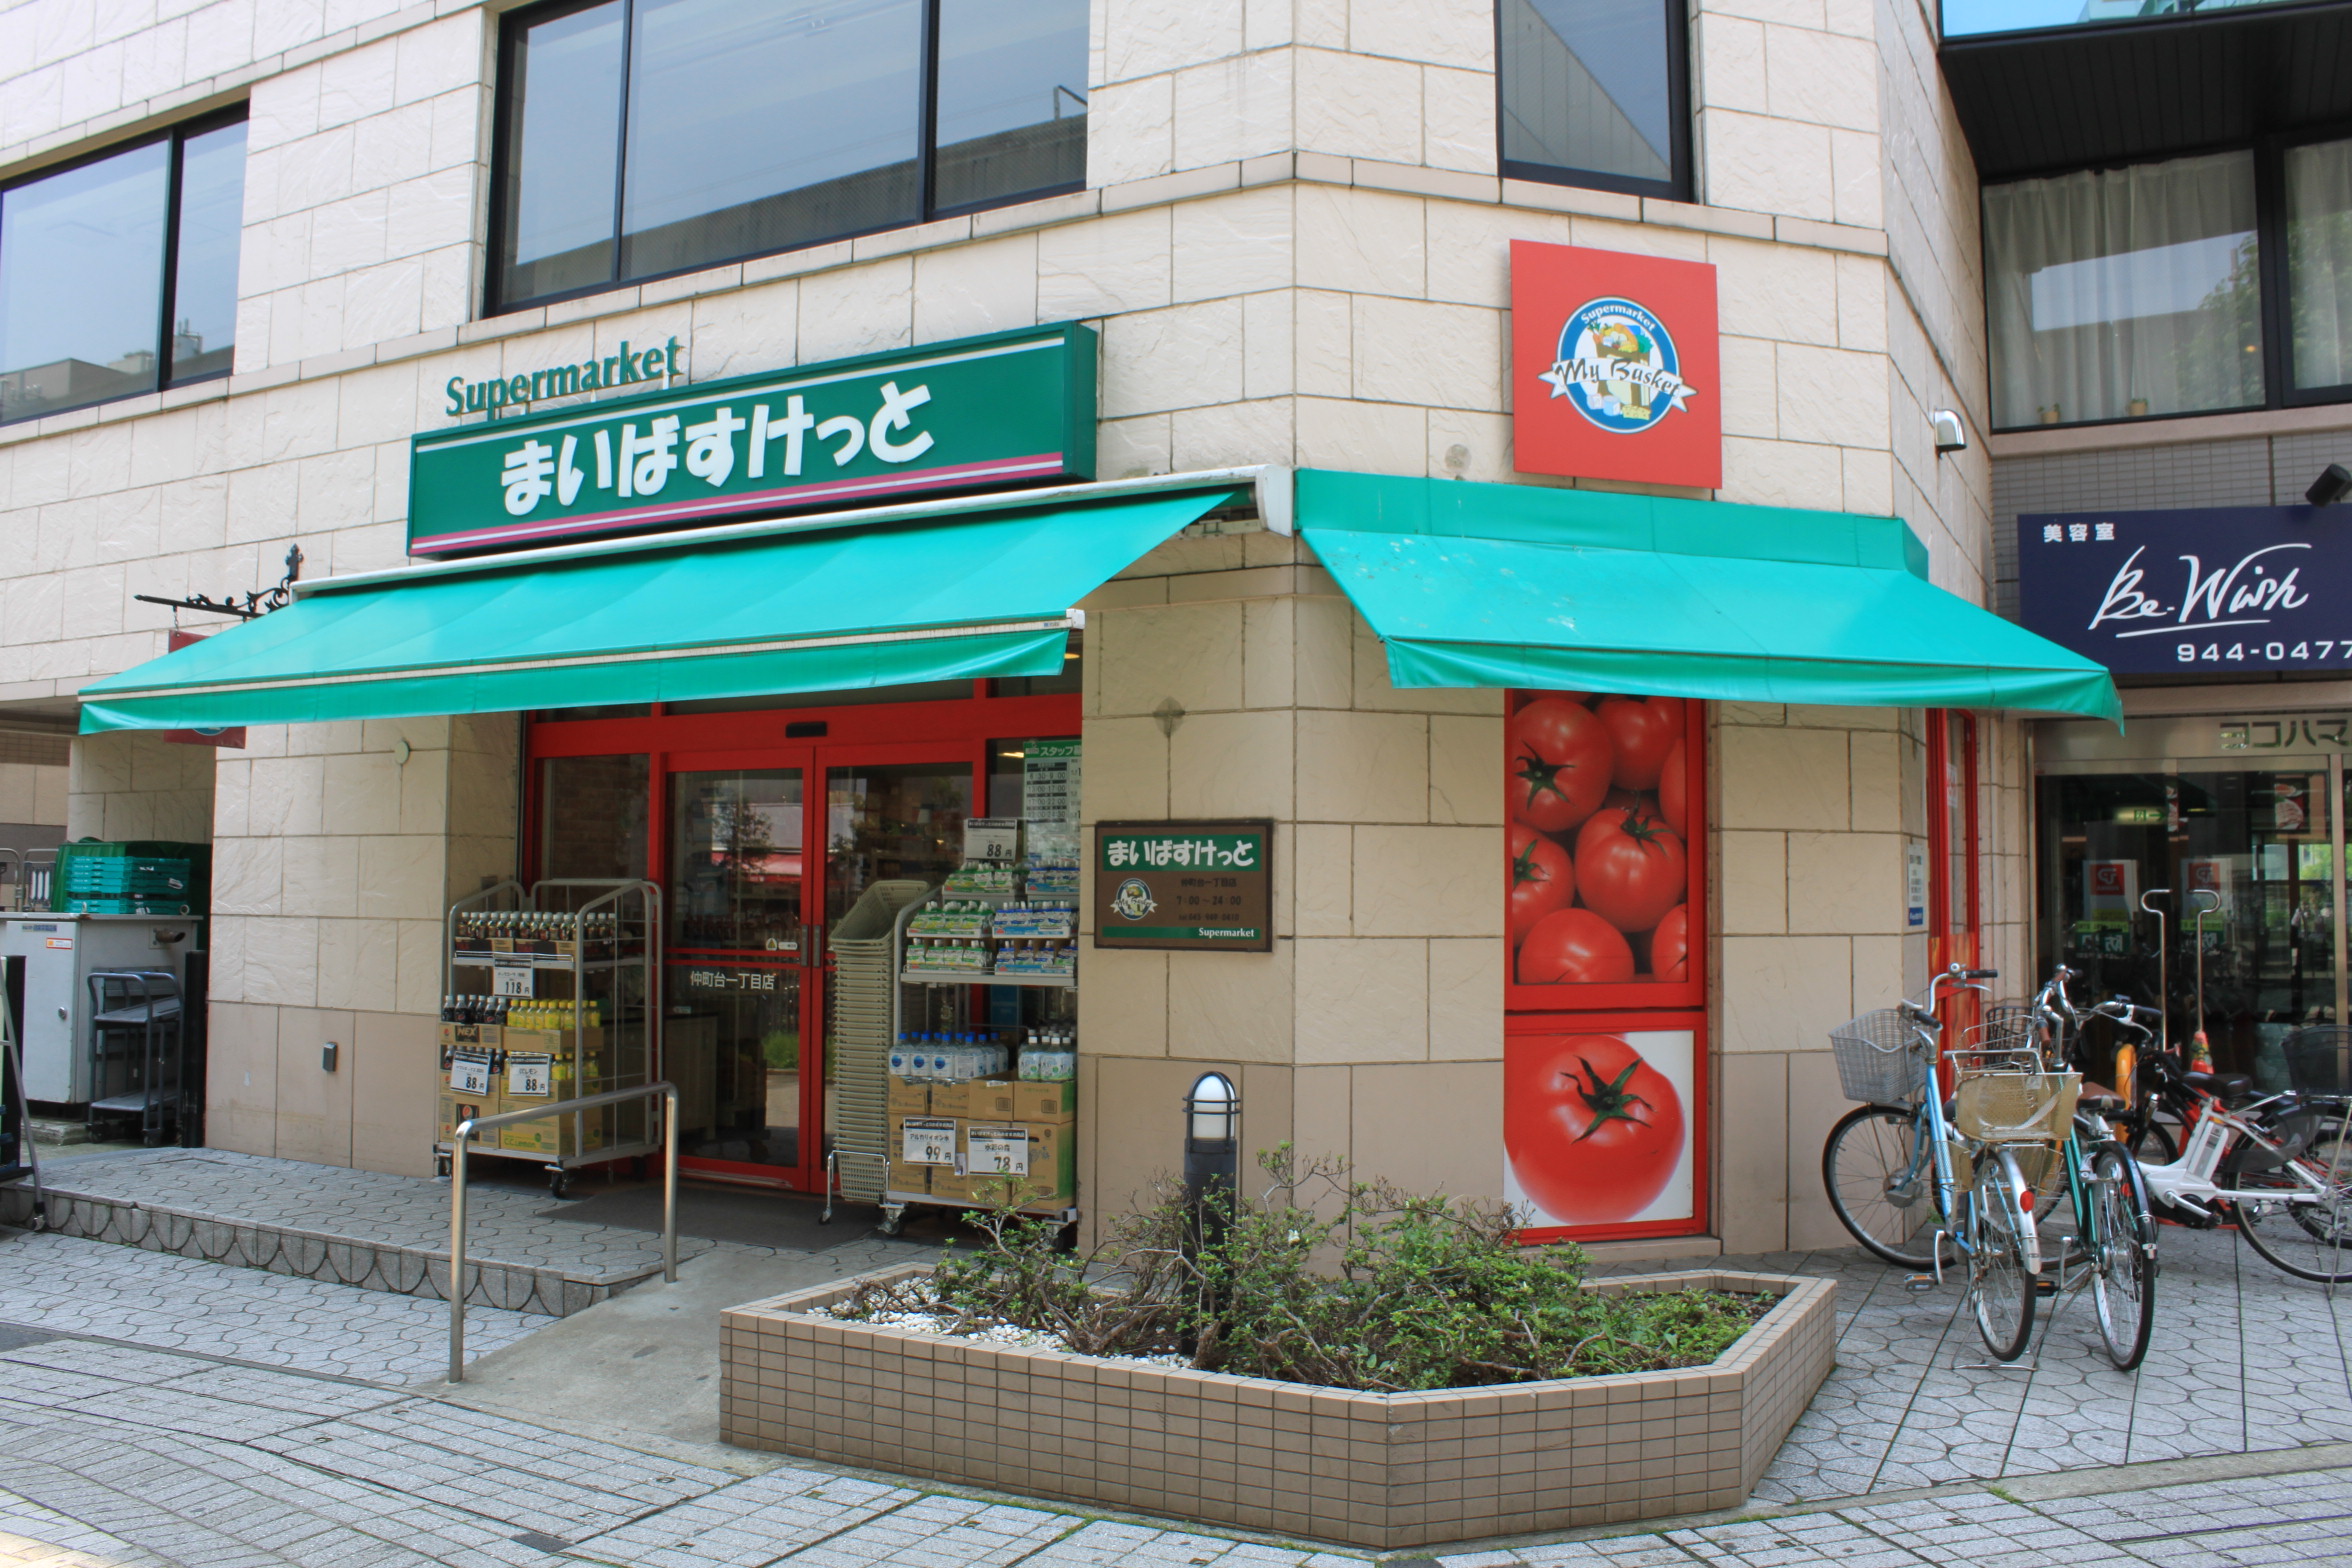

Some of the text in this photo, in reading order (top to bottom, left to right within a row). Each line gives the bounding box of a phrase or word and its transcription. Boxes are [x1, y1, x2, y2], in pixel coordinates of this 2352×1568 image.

[1581, 305, 1656, 331] Supermarket
[446, 335, 683, 421] Supermarket
[1554, 358, 1681, 397] My Basket
[501, 380, 935, 517] まいばすけっと
[2043, 522, 2116, 544] 美容室
[2087, 542, 2313, 631] Be-Wish
[2176, 640, 2352, 663] 944-0477
[2219, 719, 2350, 750] ヨコハマ
[986, 843, 1002, 858] 88
[1107, 839, 1254, 867] まいばすけっと
[1198, 927, 1254, 939] Supermarket
[505, 981, 522, 994] 118
[690, 970, 775, 991] 仲町台一丁目店
[457, 1026, 478, 1038] NEX
[465, 1076, 477, 1089] 88
[525, 1079, 538, 1091] 88
[925, 1145, 941, 1161] 99
[994, 1156, 1011, 1172] 78
